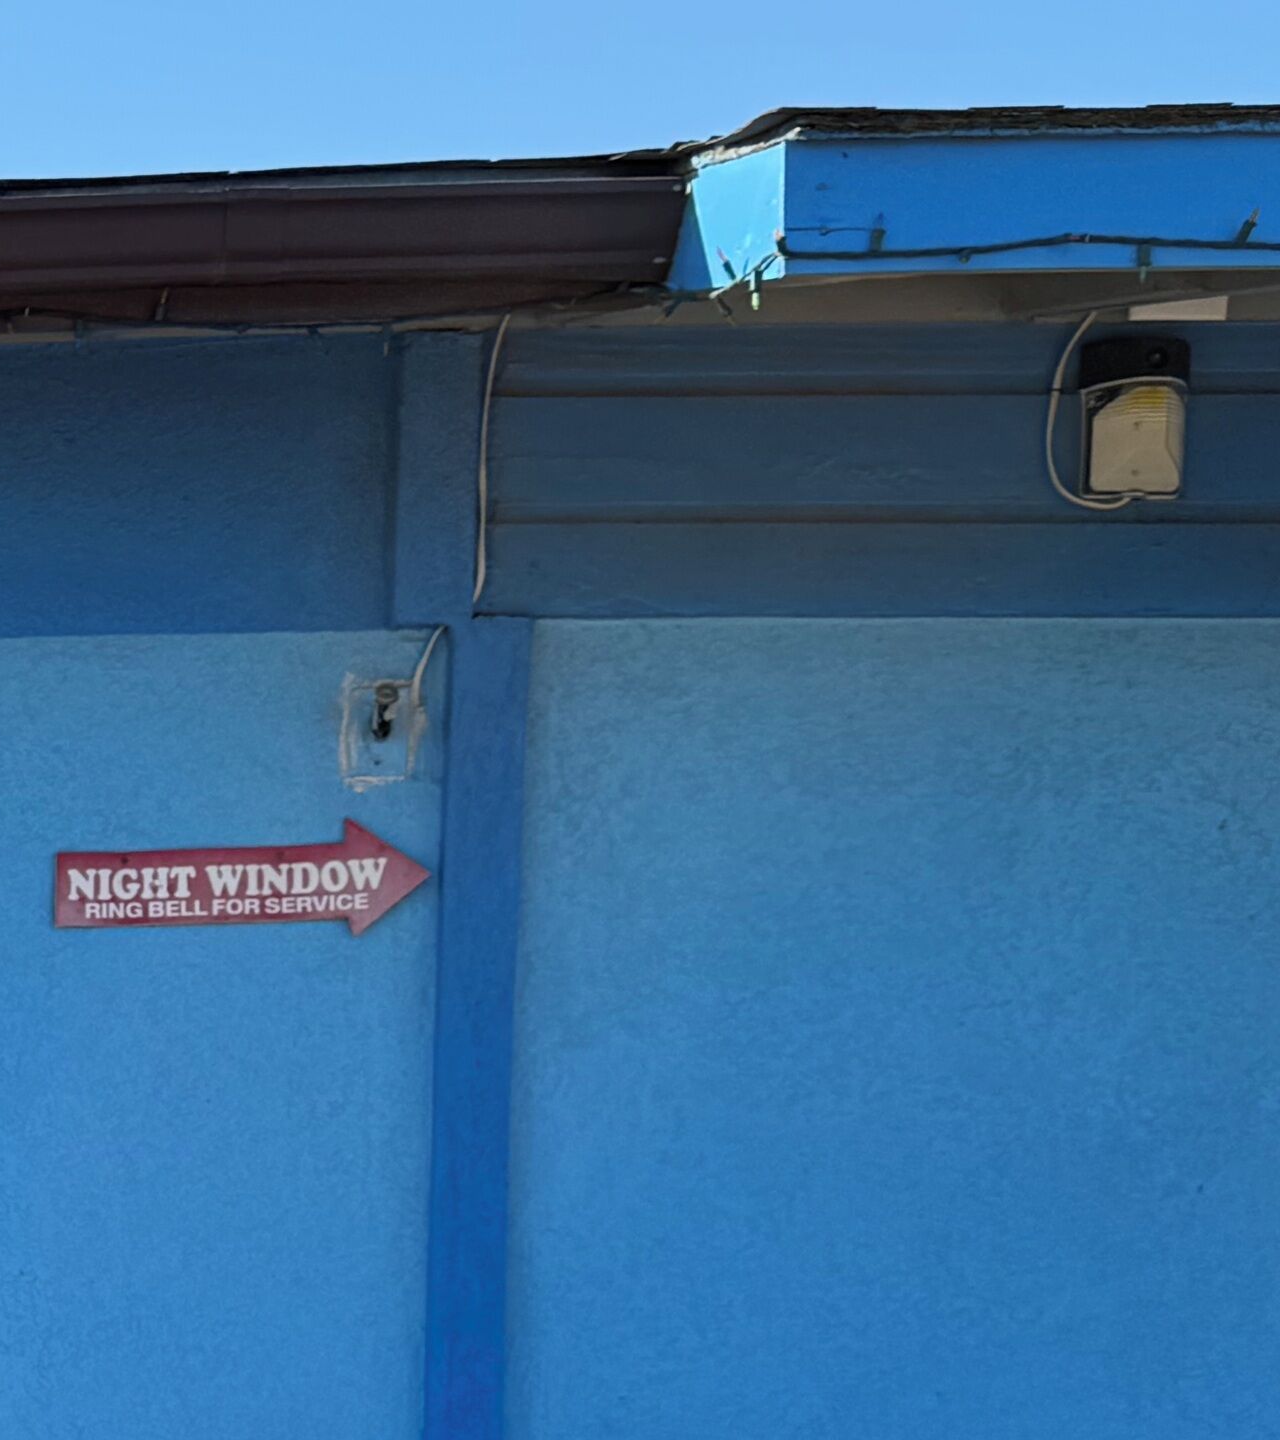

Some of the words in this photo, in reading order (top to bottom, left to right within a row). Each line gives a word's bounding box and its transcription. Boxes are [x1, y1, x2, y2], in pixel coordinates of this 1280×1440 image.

[67, 865, 196, 900] NIGHT
[204, 857, 388, 897] WINDOW
[85, 902, 143, 919] RING
[148, 899, 208, 918] BELL
[212, 897, 260, 916] FOR
[264, 892, 370, 914] SERVICE
